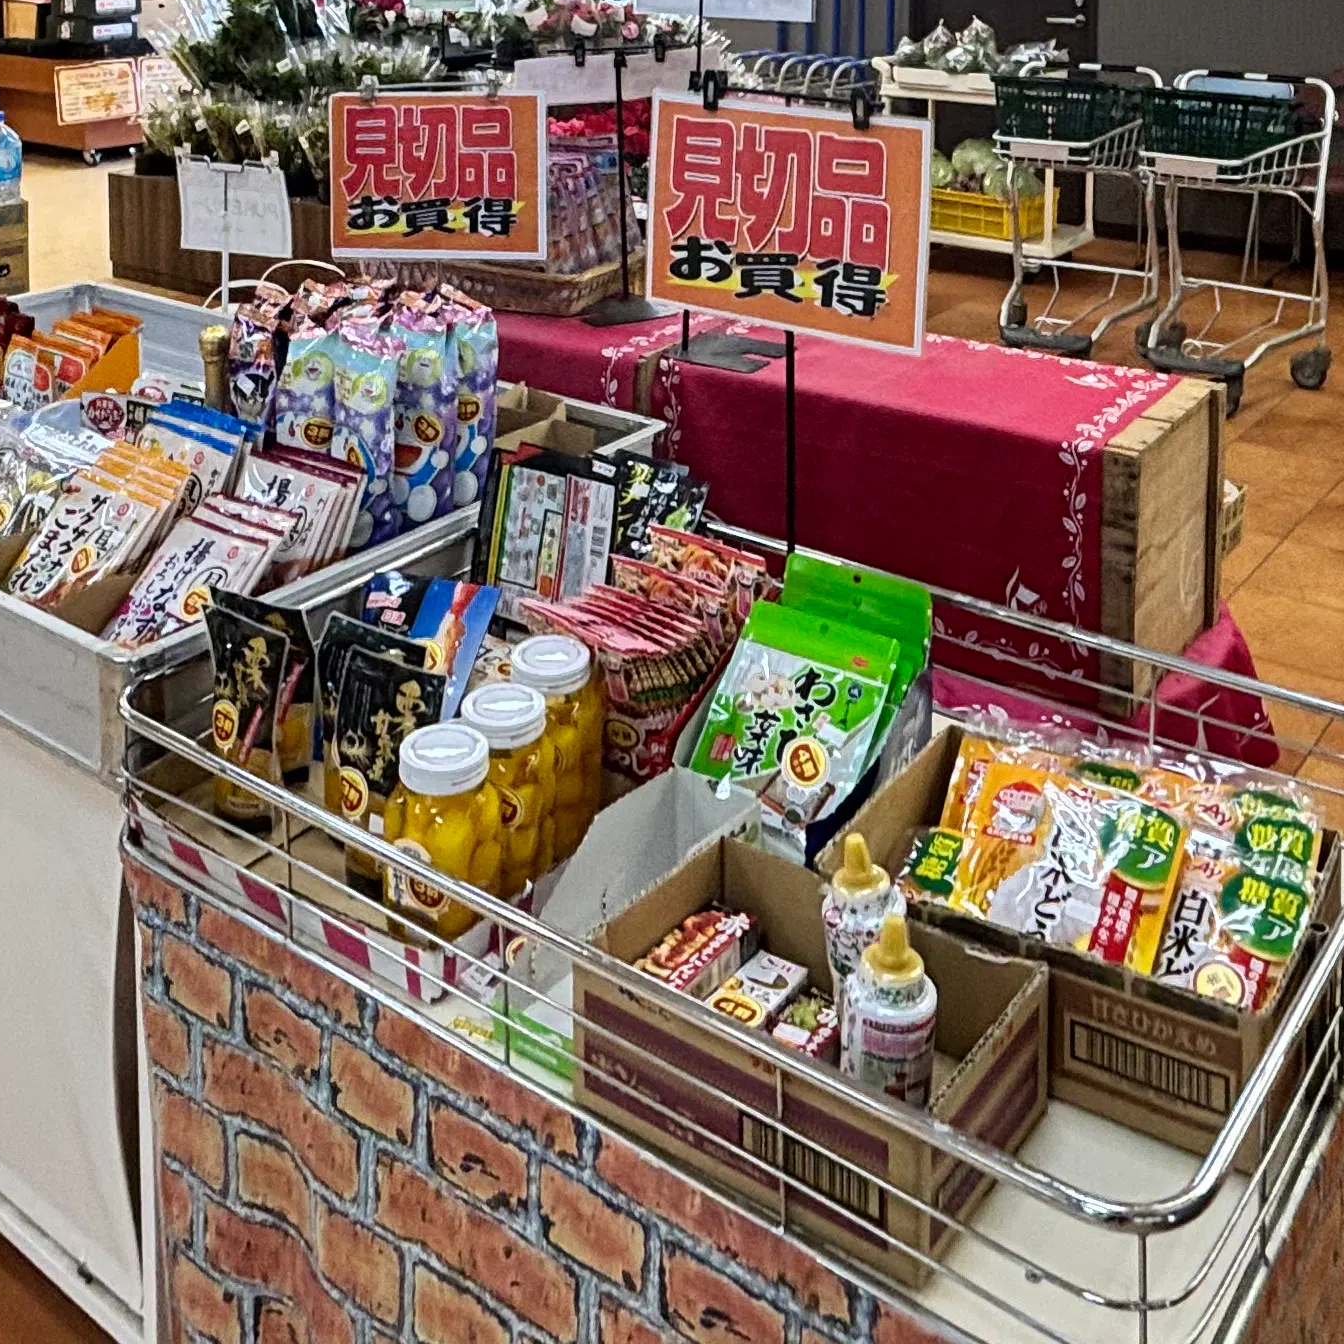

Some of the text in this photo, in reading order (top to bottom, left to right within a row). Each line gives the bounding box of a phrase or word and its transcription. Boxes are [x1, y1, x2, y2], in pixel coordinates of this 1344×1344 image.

[342, 104, 519, 202] 見切品
[663, 114, 892, 273] 見切品
[346, 195, 519, 238] お買得
[668, 234, 889, 320] お買得
[11, 507, 86, 593] ごまだれ
[131, 538, 217, 641] 揚げなす
[1239, 876, 1303, 924] 糖質
